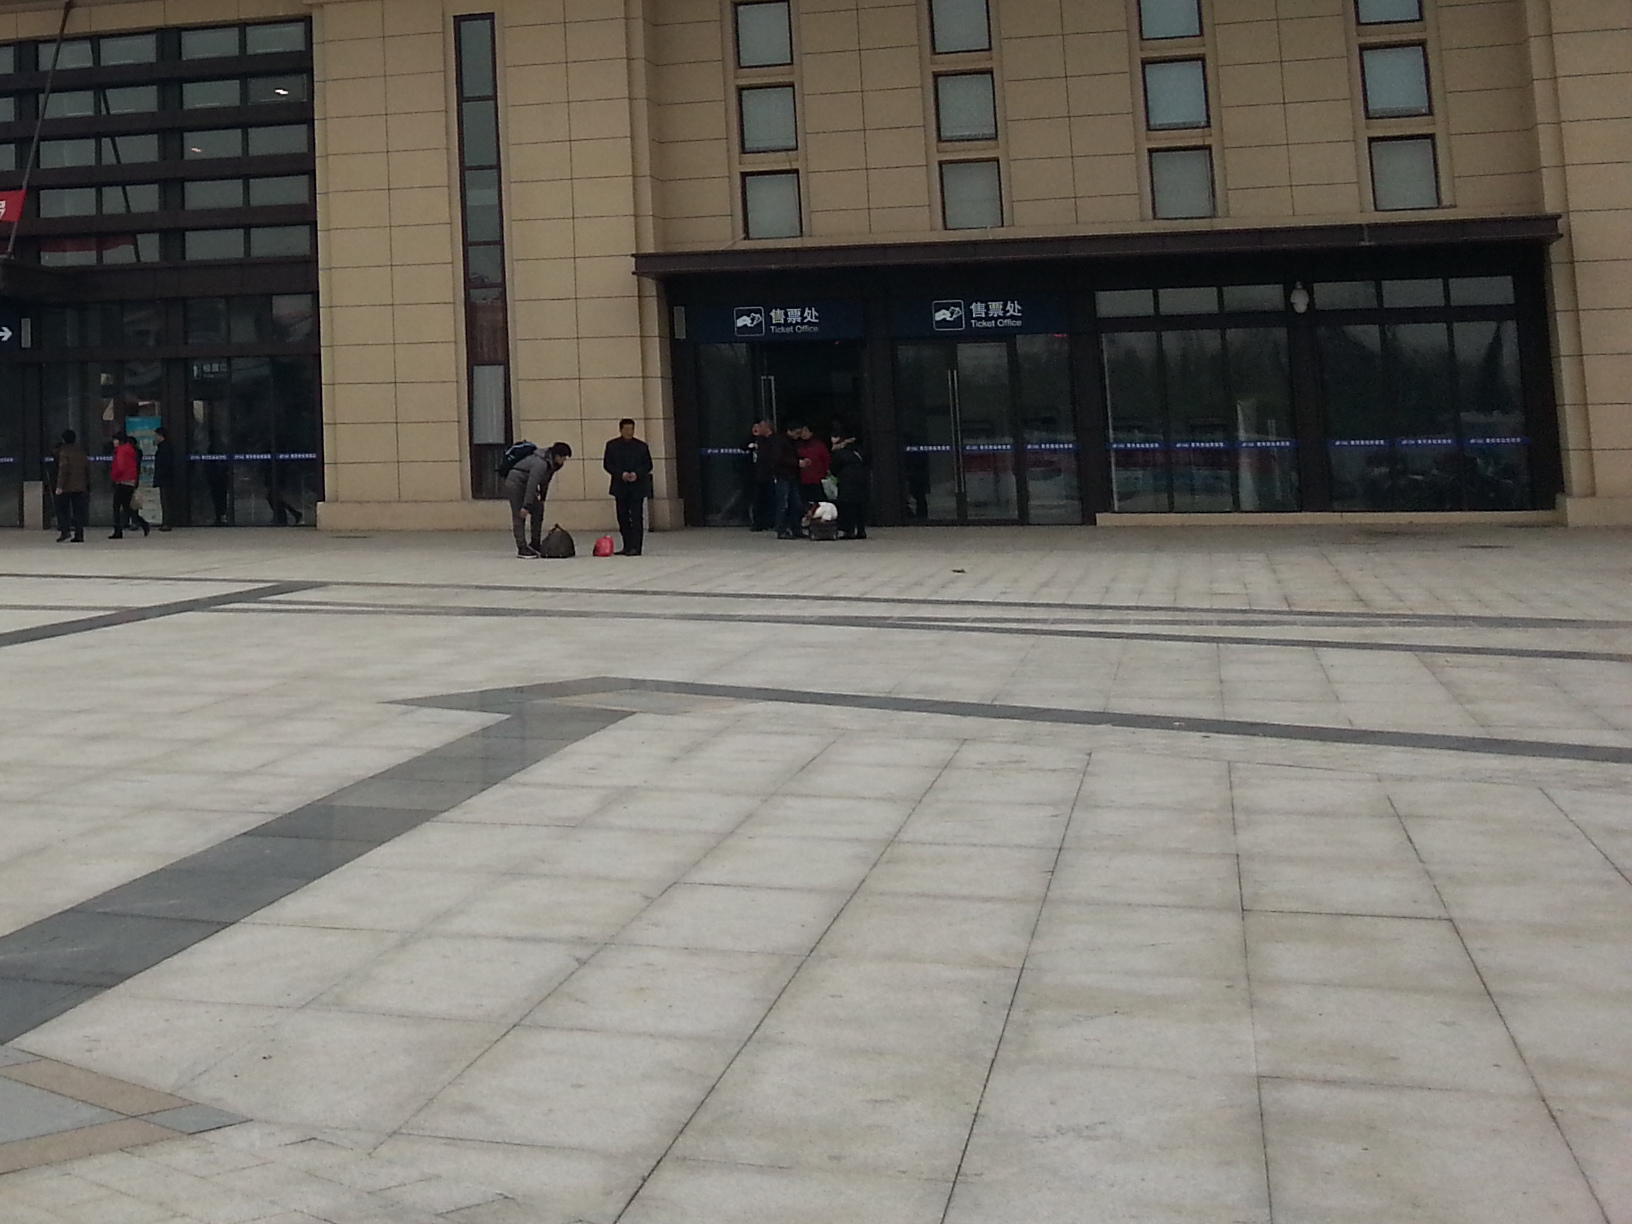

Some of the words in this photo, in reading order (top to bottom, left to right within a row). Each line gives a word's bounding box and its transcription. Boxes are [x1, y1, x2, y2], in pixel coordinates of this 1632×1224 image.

[769, 307, 819, 324] 售票处
[969, 300, 1023, 318] 售票处
[769, 326, 794, 334] Ticket
[795, 325, 819, 333] Office
[970, 319, 995, 328] Ticket
[997, 318, 1022, 327] Office
